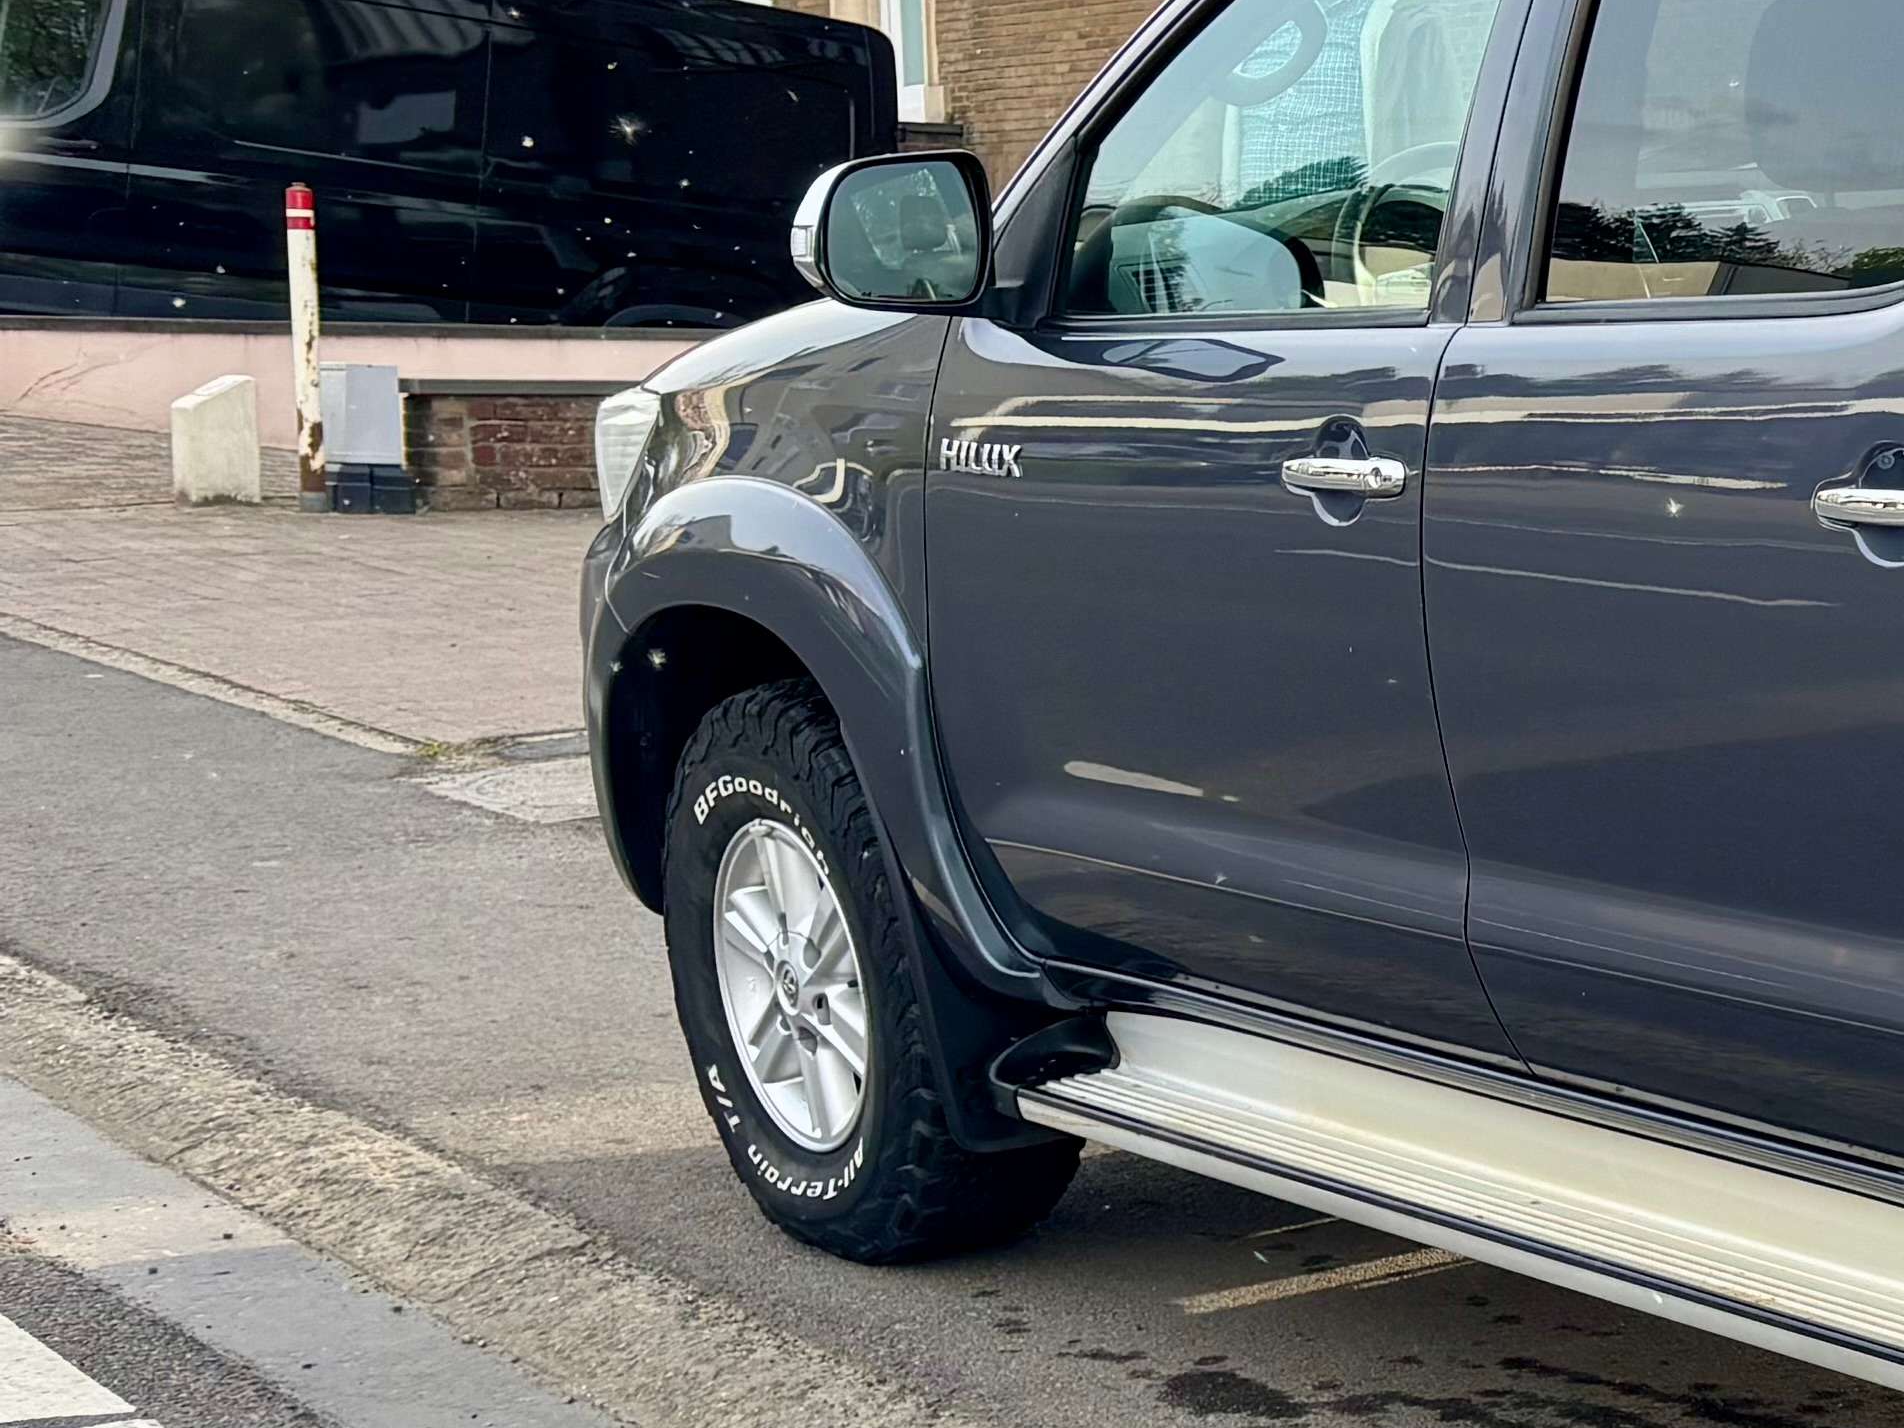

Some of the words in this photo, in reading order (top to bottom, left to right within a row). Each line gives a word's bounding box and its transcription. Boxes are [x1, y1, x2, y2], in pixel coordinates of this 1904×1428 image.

[941, 438, 1023, 478] HILUX
[693, 773, 830, 877] BFGoodrich
[705, 1063, 742, 1134] T/A
[746, 1136, 865, 1201] All-Terrain
